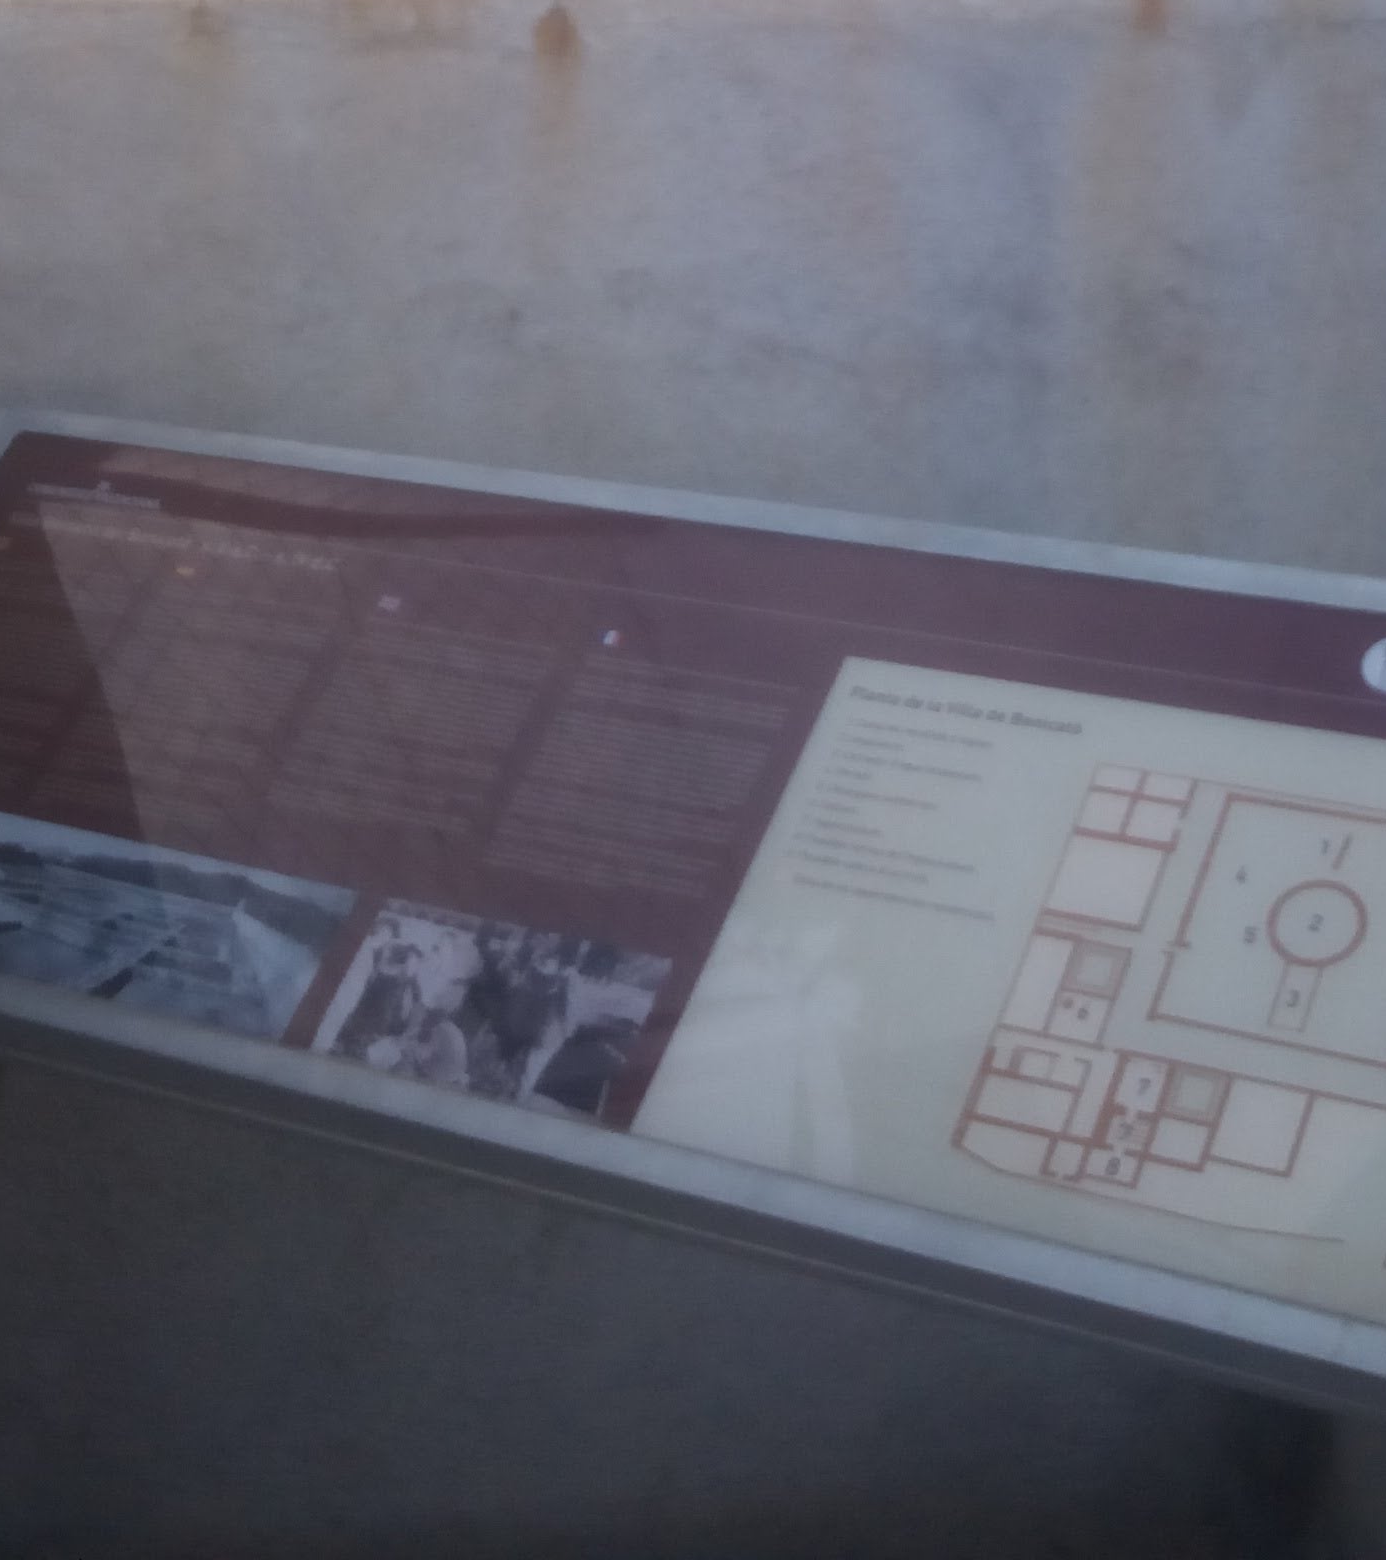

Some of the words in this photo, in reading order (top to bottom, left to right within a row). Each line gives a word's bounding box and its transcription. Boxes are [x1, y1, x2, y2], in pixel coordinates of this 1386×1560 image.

[904, 695, 925, 710] de
[985, 709, 1006, 723] de
[1307, 913, 1324, 932] 2
[1286, 989, 1300, 1008] 3
